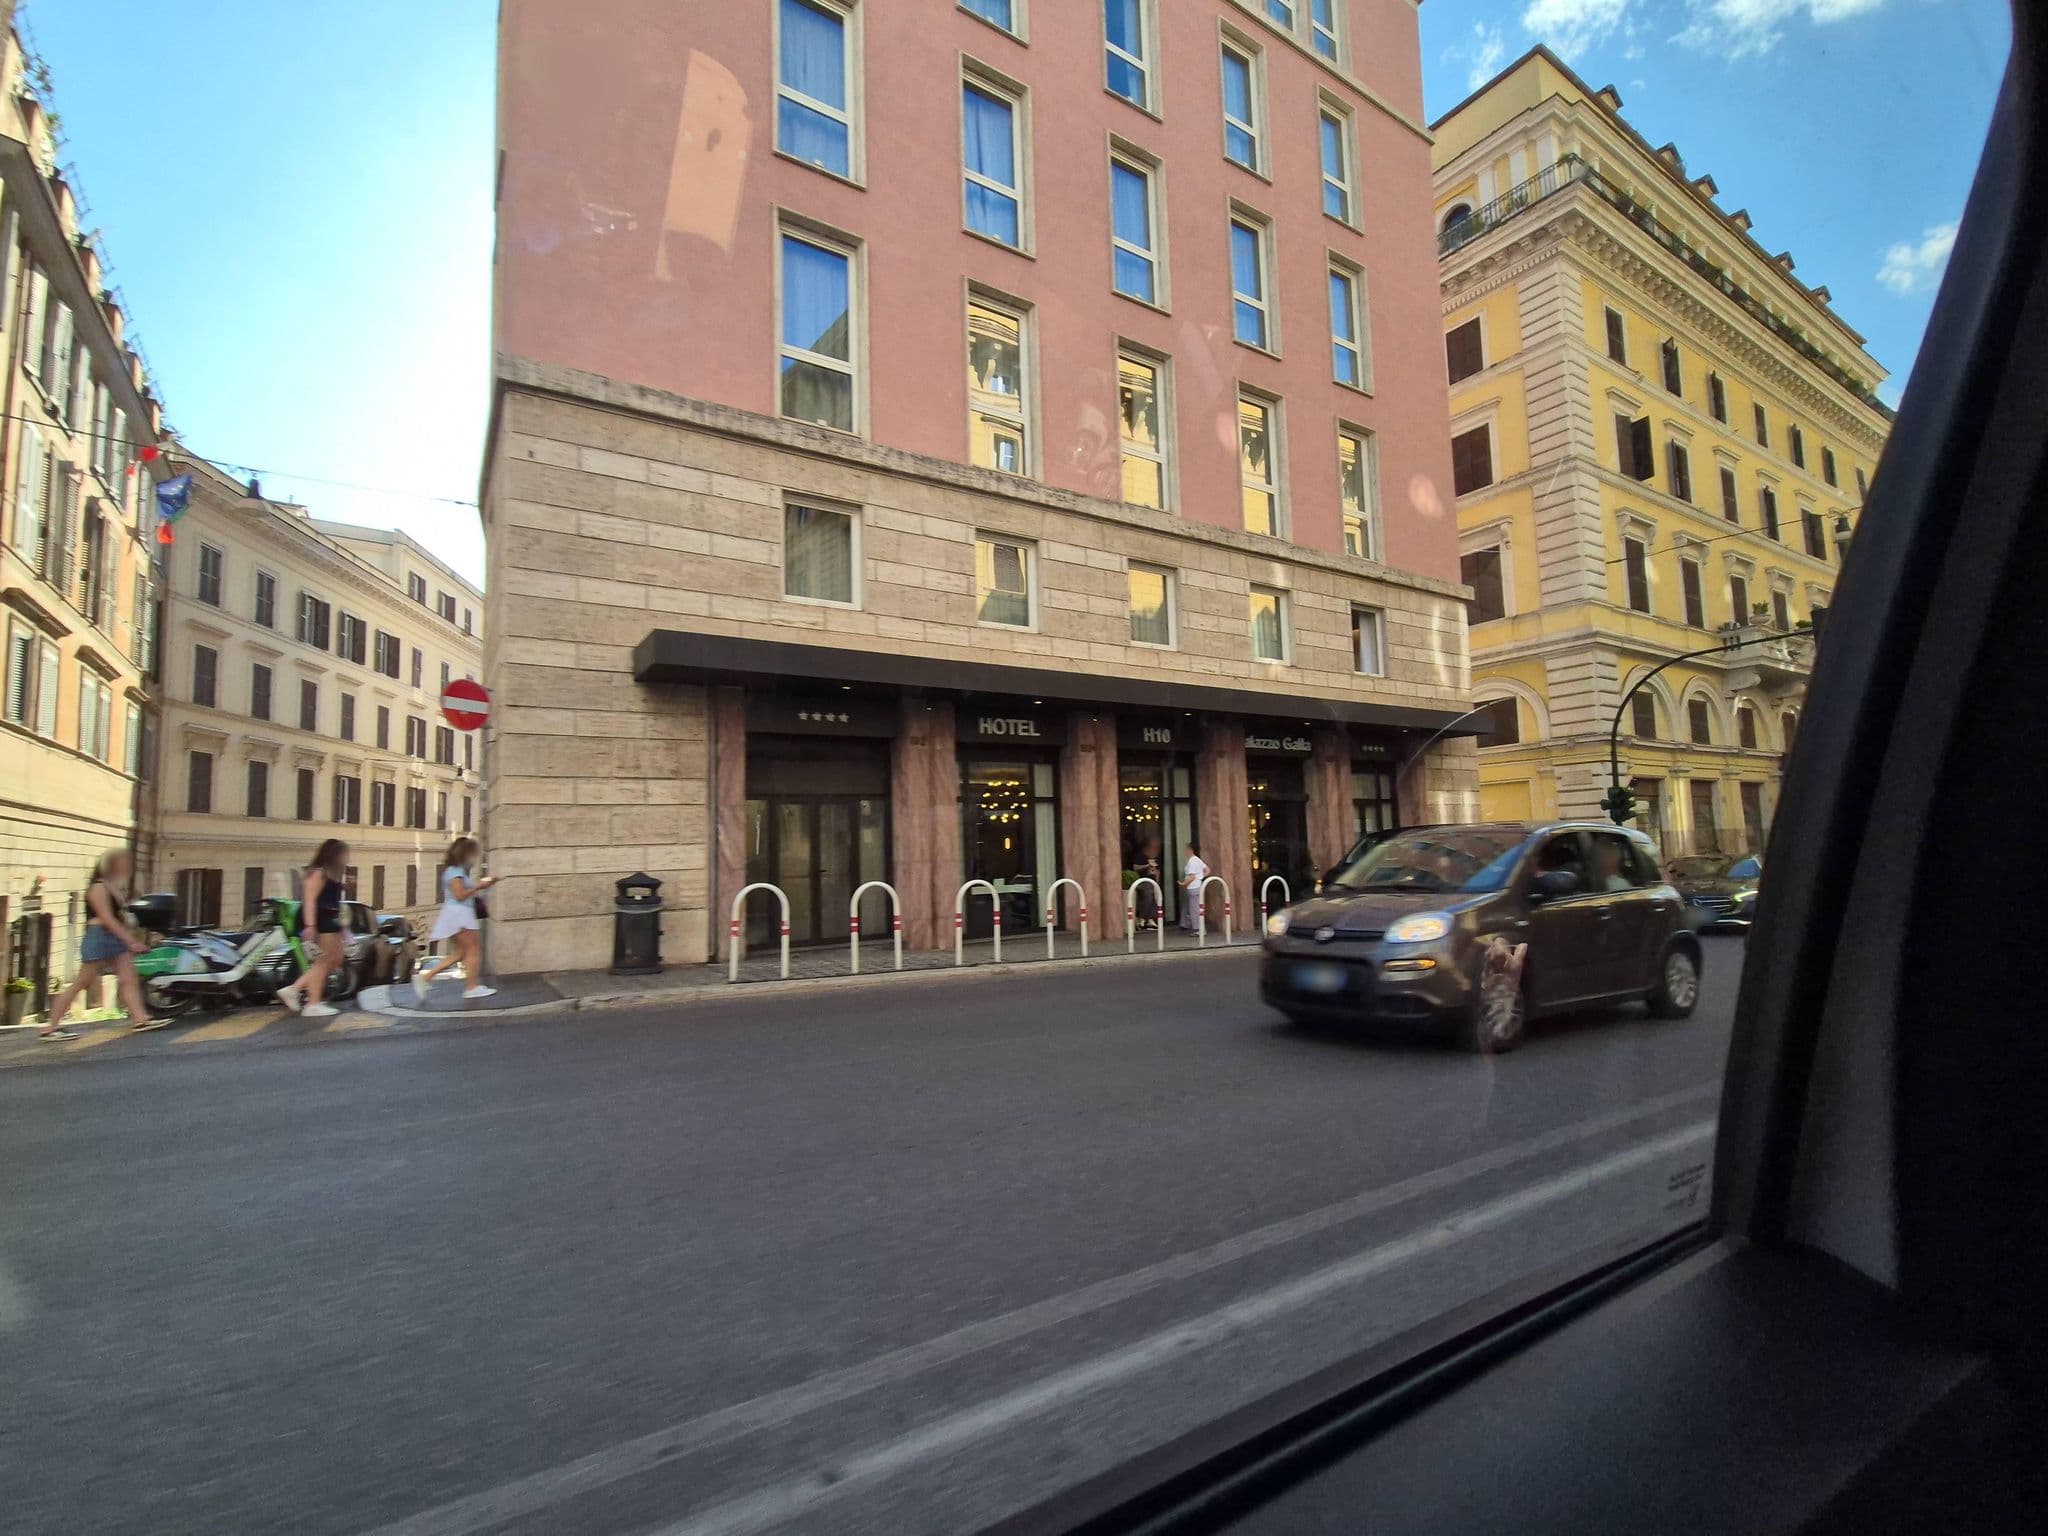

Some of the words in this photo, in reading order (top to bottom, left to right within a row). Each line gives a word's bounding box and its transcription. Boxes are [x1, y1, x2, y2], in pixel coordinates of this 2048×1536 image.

[979, 717, 1041, 737] HOTEL
[1143, 727, 1171, 744] H10
[1244, 736, 1281, 750] alazzo
